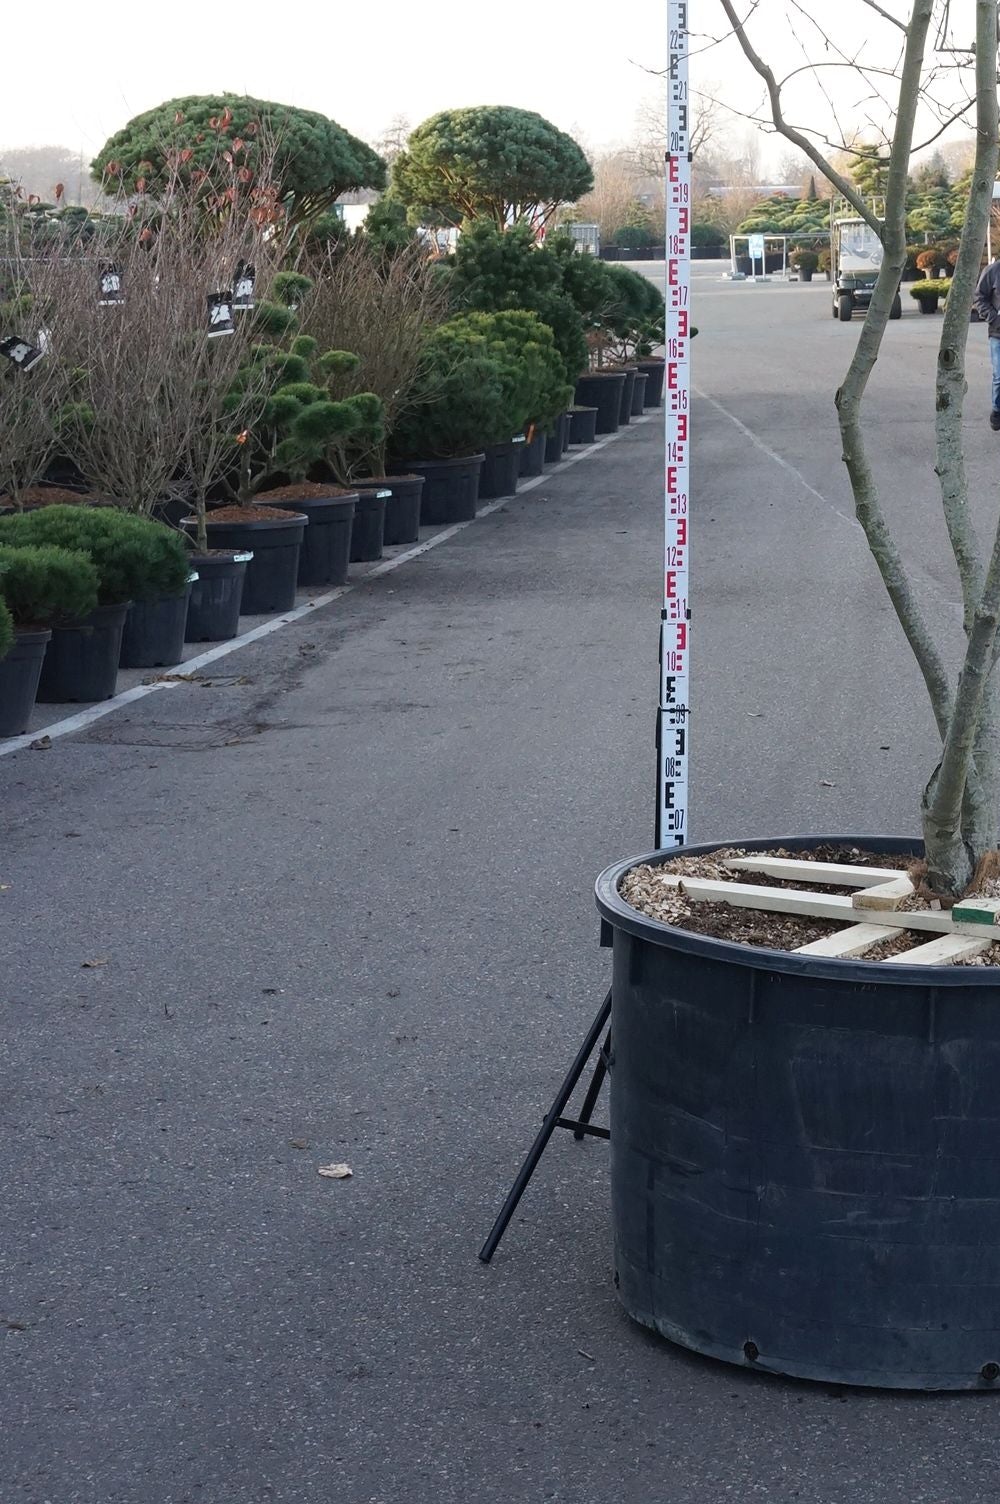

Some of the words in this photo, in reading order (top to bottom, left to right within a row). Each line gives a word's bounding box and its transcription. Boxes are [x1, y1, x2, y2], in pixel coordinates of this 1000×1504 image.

[670, 30, 678, 49] 22
[679, 81, 687, 100] 21
[671, 132, 679, 151] 20
[680, 184, 688, 203] 19
[669, 235, 678, 254] 18
[678, 286, 687, 305] 17
[669, 338, 677, 358] 16
[678, 390, 687, 409] 15
[668, 442, 676, 462] 14
[678, 494, 687, 513] 13
[667, 547, 676, 566] 12
[676, 599, 687, 618] 11
[667, 651, 676, 671] 10
[666, 757, 675, 777] 08
[674, 809, 684, 829] 07
